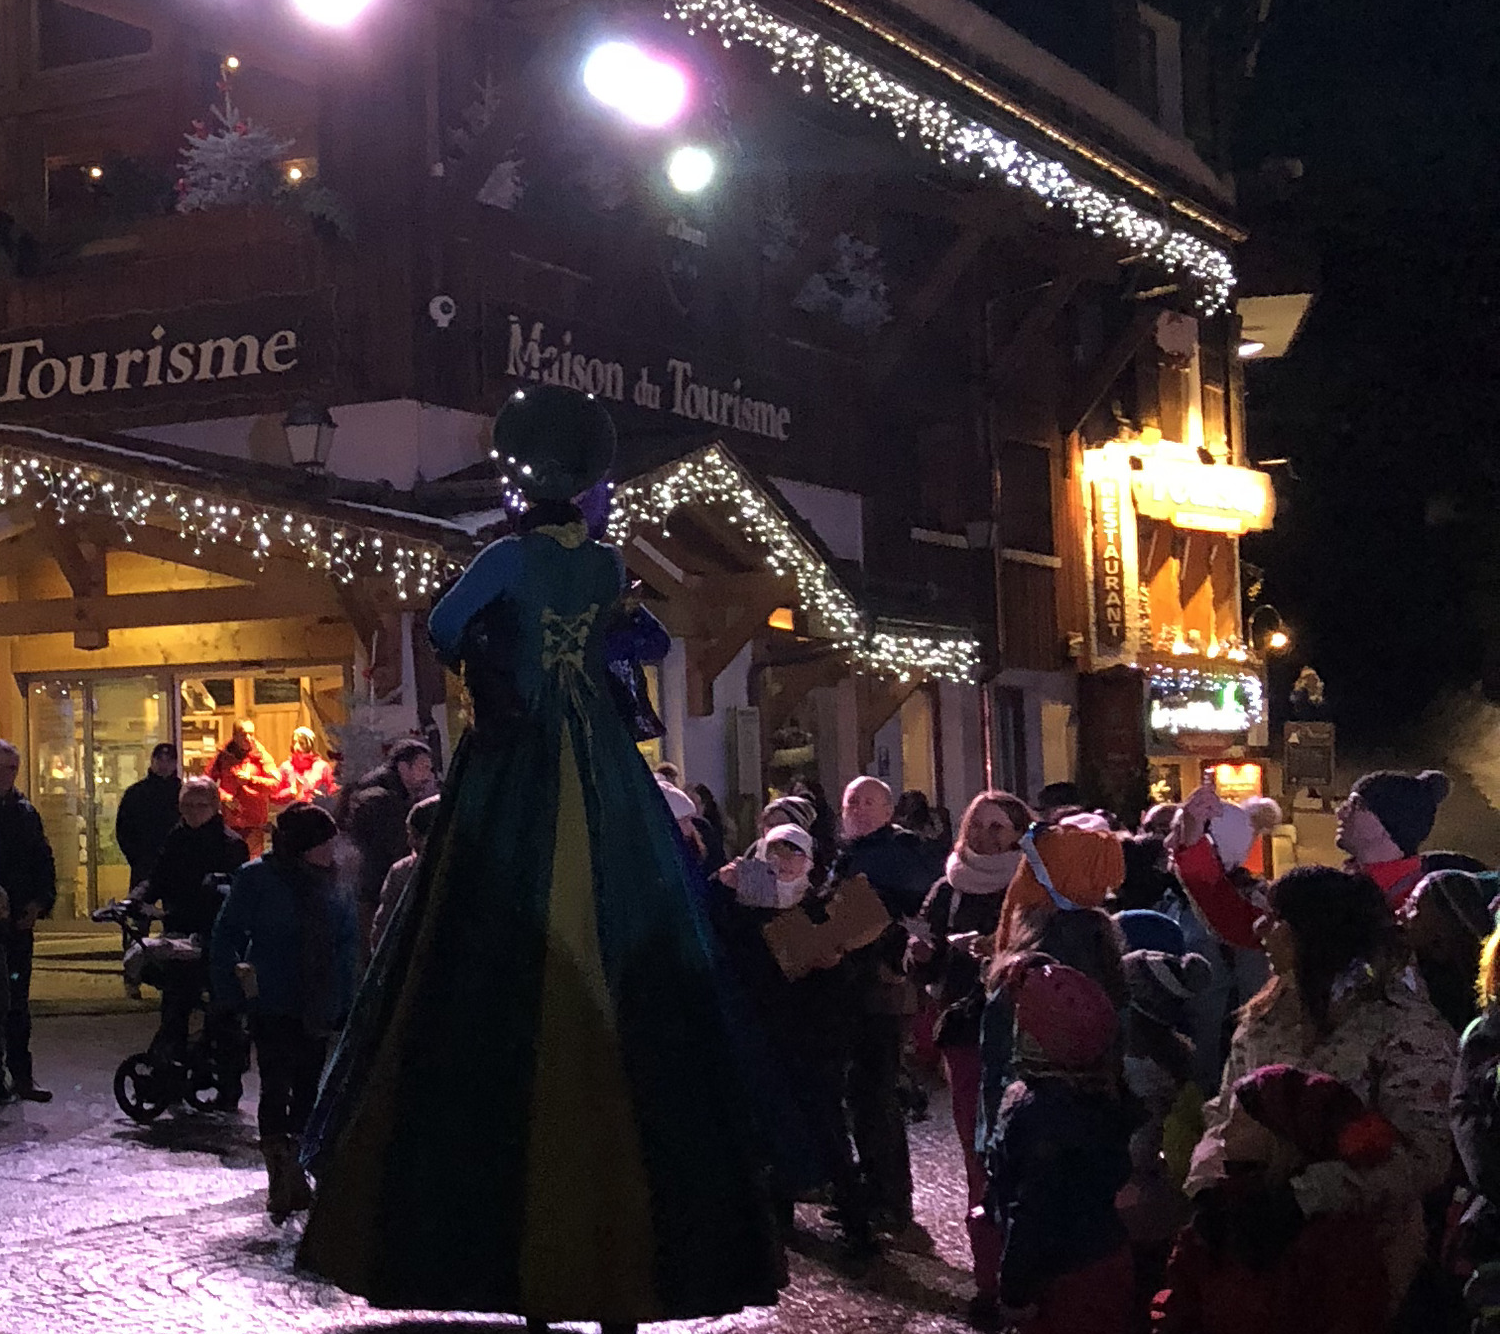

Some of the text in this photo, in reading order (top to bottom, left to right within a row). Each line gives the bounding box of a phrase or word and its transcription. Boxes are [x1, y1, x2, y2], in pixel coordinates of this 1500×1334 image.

[505, 314, 791, 441] Maison du Tourisme
[1100, 481, 1122, 637] RESTAURANT
